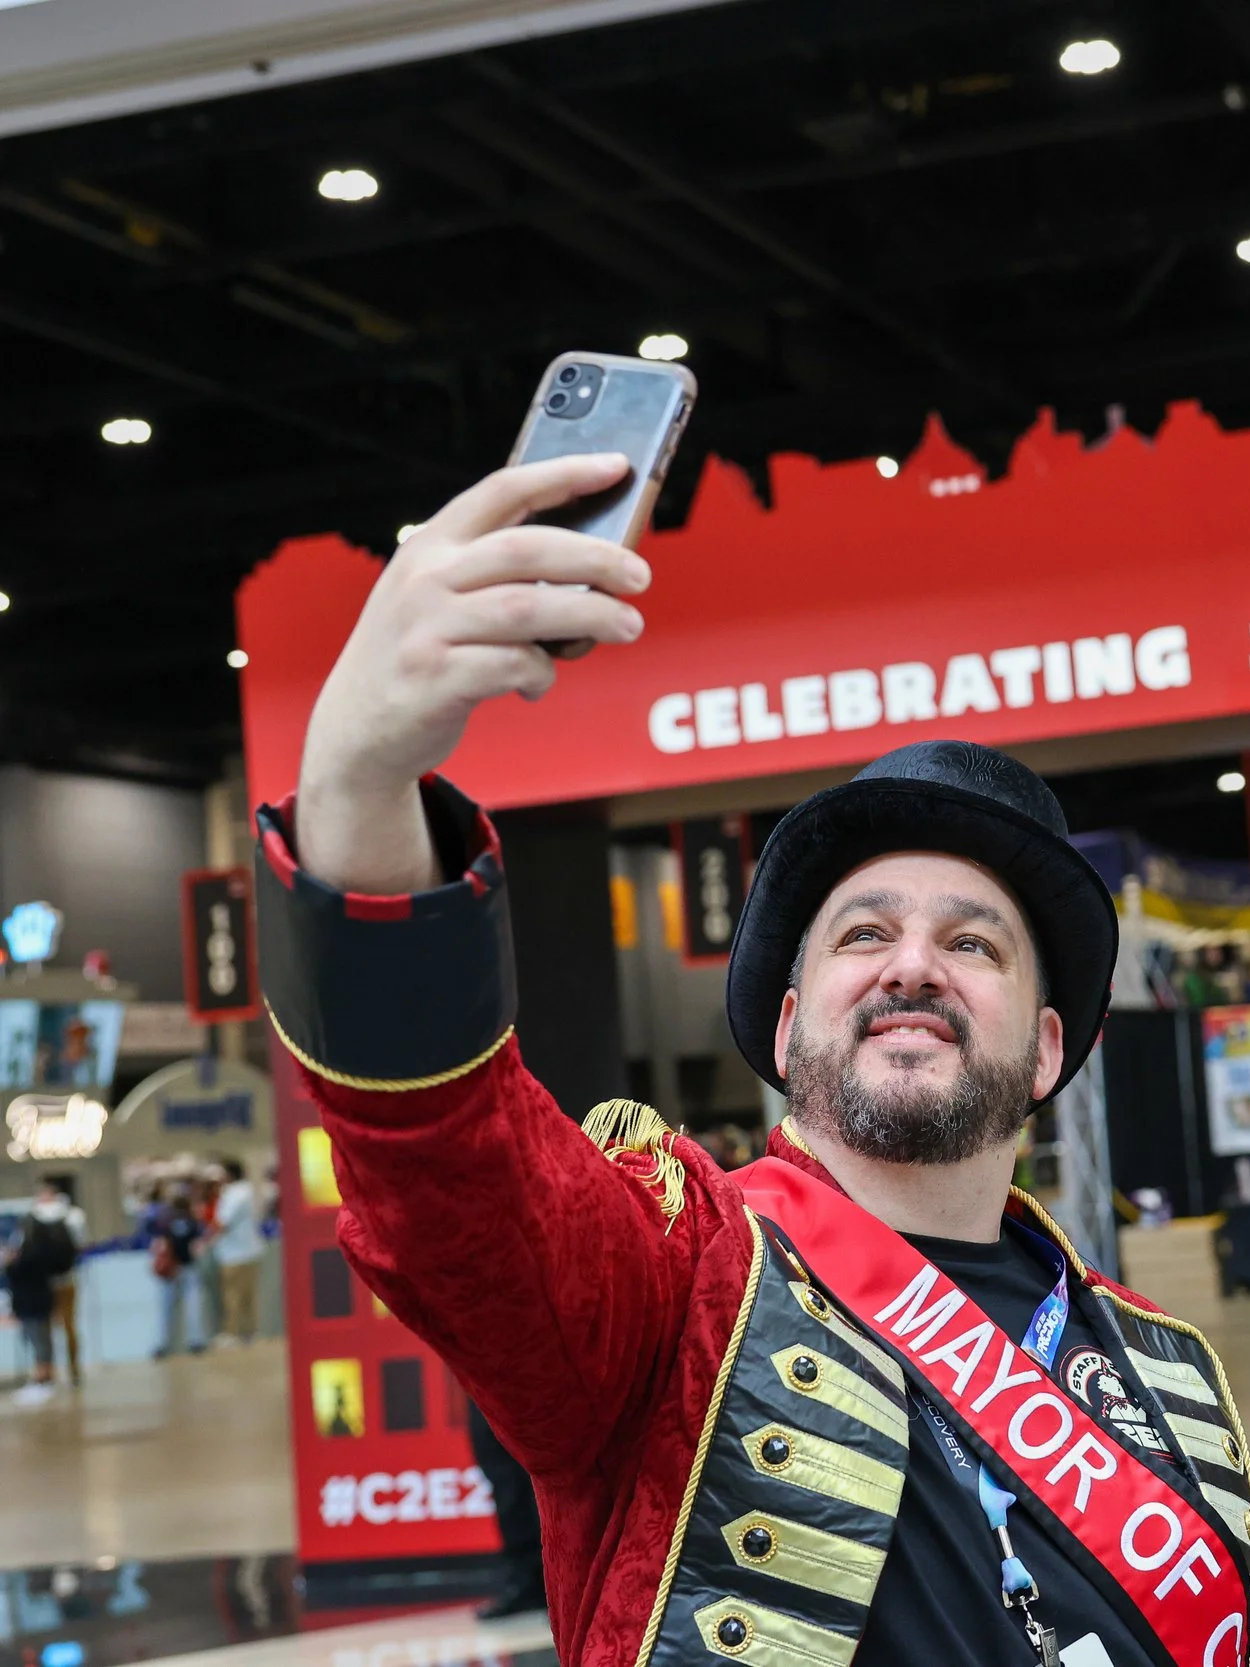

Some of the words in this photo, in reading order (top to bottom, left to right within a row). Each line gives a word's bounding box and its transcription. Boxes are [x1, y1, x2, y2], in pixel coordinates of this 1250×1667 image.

[647, 624, 1193, 755] CELEBRATING
[1073, 1356, 1098, 1391] STAFF
[872, 1262, 1118, 1514] MAYOR
[1120, 1500, 1222, 1601] OF
[320, 1466, 495, 1527] #C2E2
